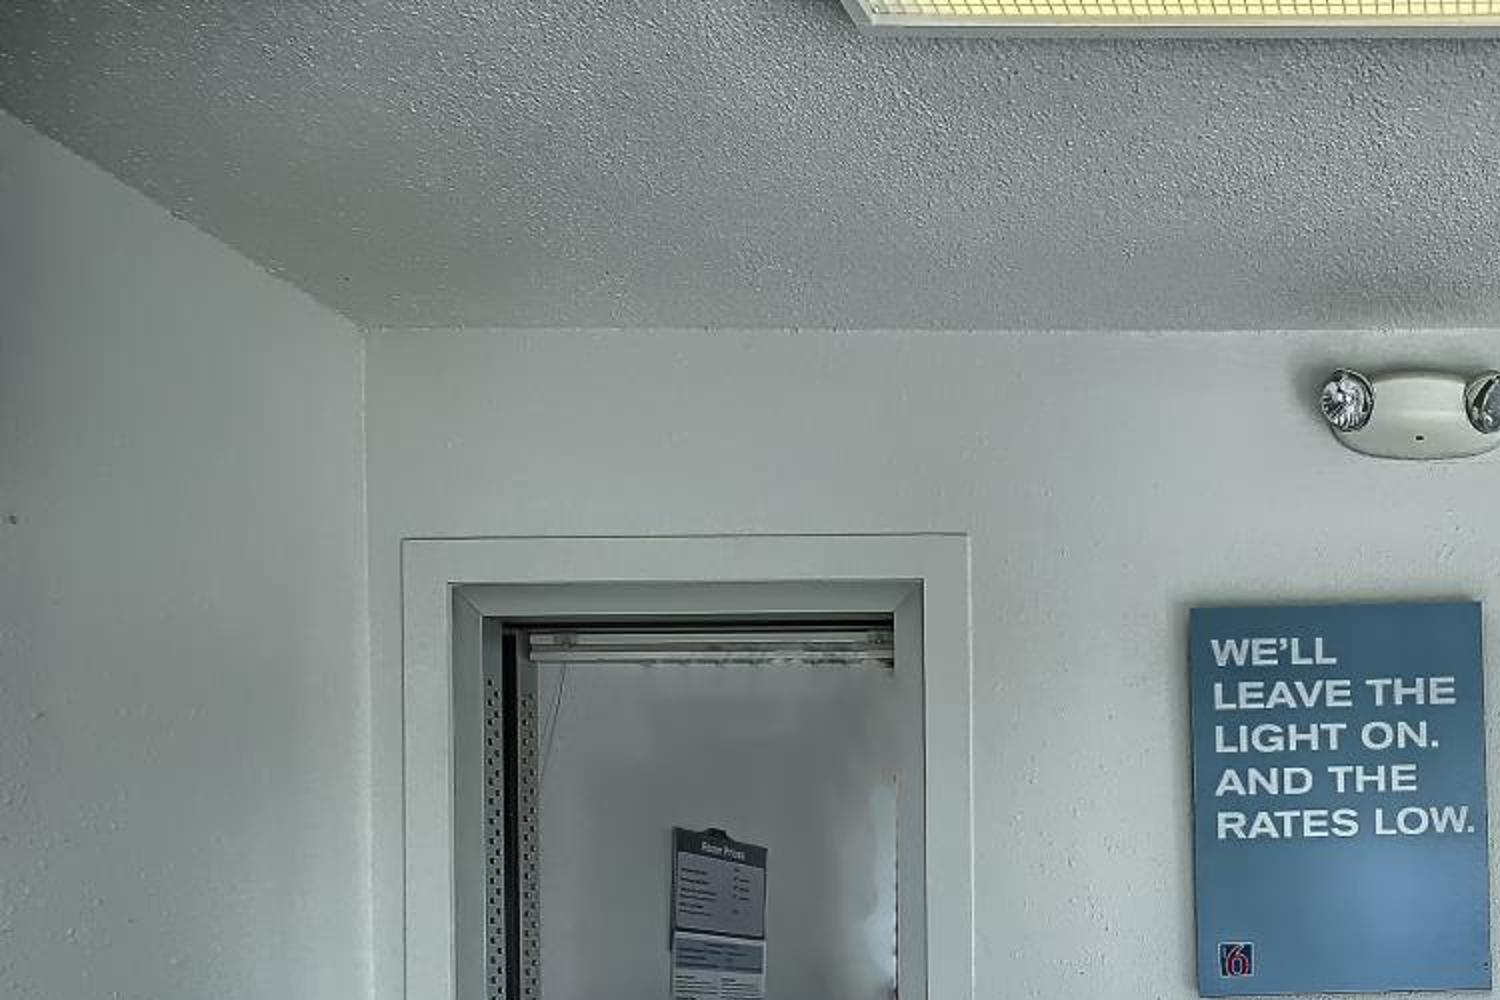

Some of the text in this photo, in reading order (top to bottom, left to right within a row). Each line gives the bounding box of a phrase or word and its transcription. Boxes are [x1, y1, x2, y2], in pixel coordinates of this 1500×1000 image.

[1210, 637, 1338, 667] WE'LL
[1213, 676, 1456, 710] LEAVE THE
[1215, 720, 1440, 753] LIGHT ON.
[1215, 763, 1417, 797] AND THE
[1216, 805, 1475, 840] RATES LOW.
